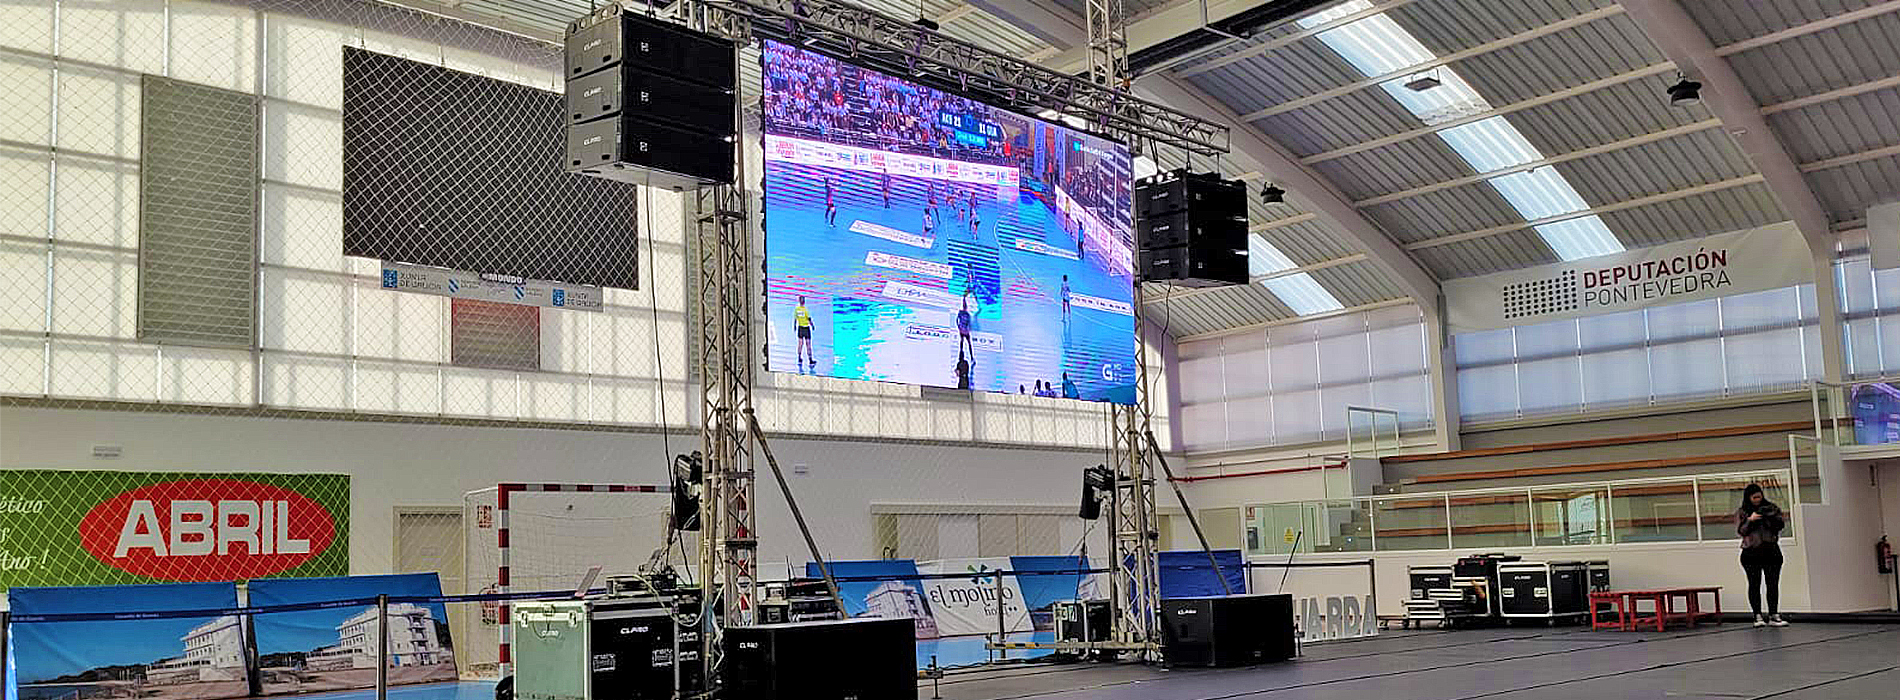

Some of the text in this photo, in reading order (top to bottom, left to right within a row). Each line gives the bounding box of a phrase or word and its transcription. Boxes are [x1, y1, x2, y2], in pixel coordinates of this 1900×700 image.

[1584, 247, 1728, 289] DEPUTACIÓN
[1584, 270, 1732, 307] PONTEVEDRA
[114, 499, 311, 559] ABRIL
